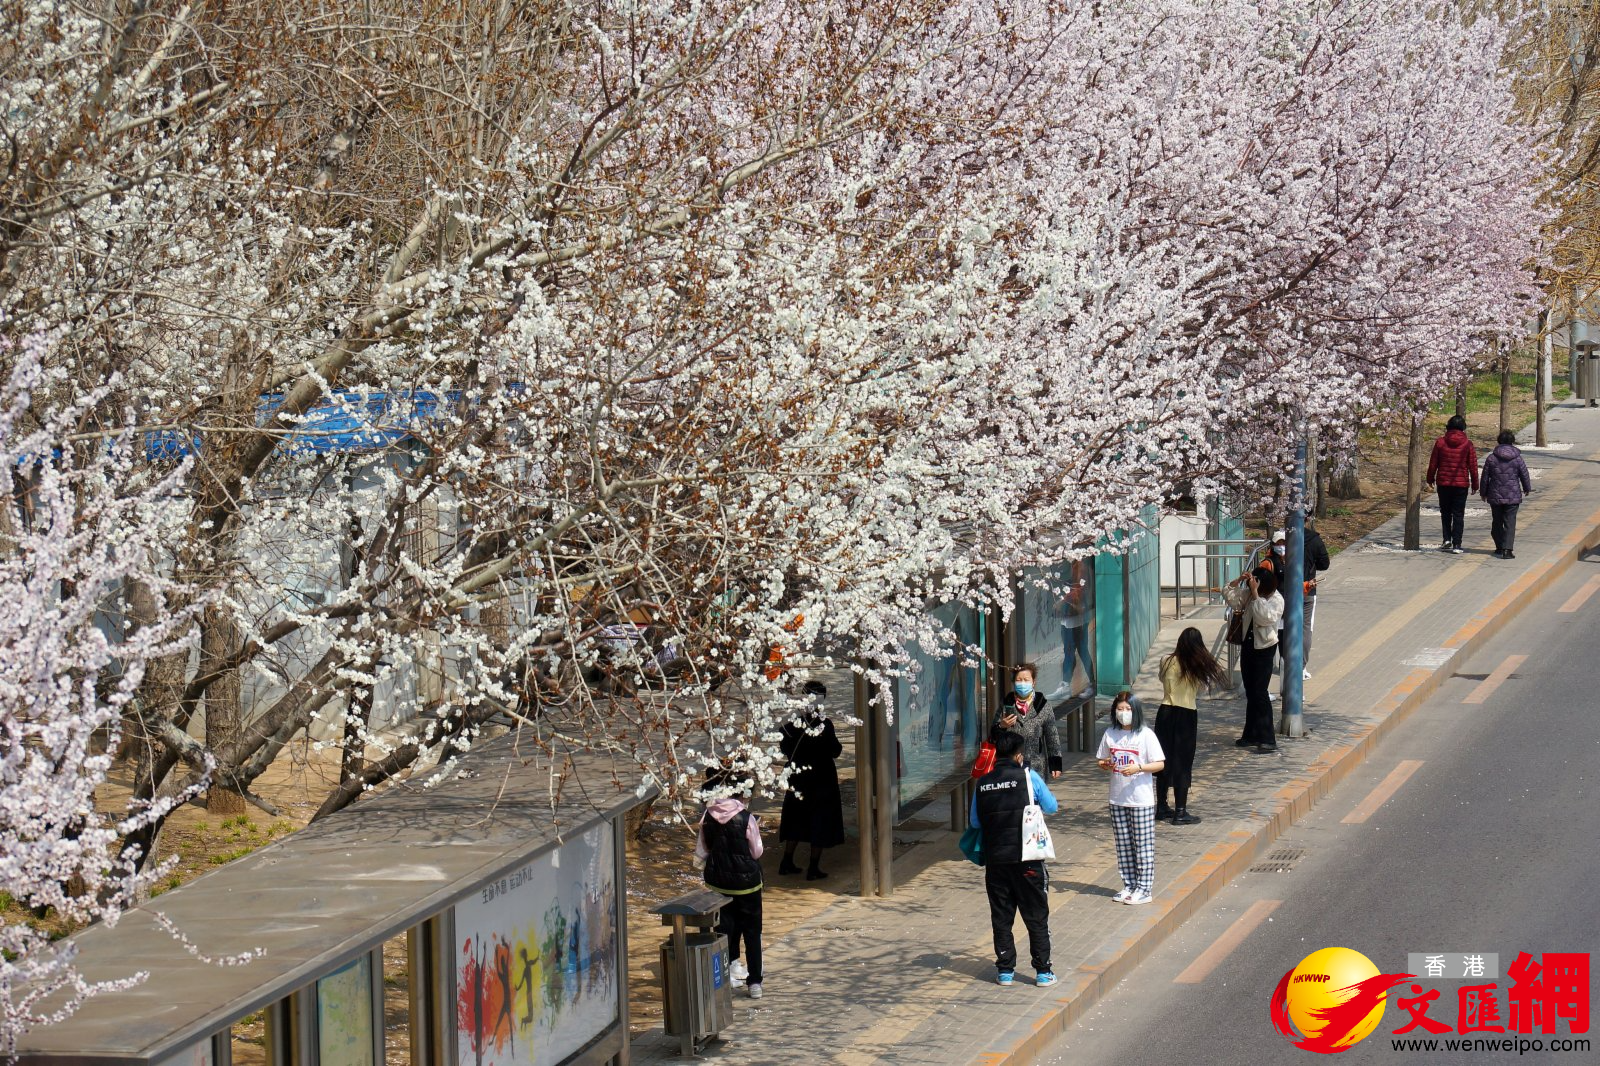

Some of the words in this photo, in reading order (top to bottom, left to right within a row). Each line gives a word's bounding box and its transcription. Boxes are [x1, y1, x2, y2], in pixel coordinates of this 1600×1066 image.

[980, 781, 1011, 792] KELME
[482, 879, 508, 904] 生命不息
[509, 865, 534, 890] 运动不止
